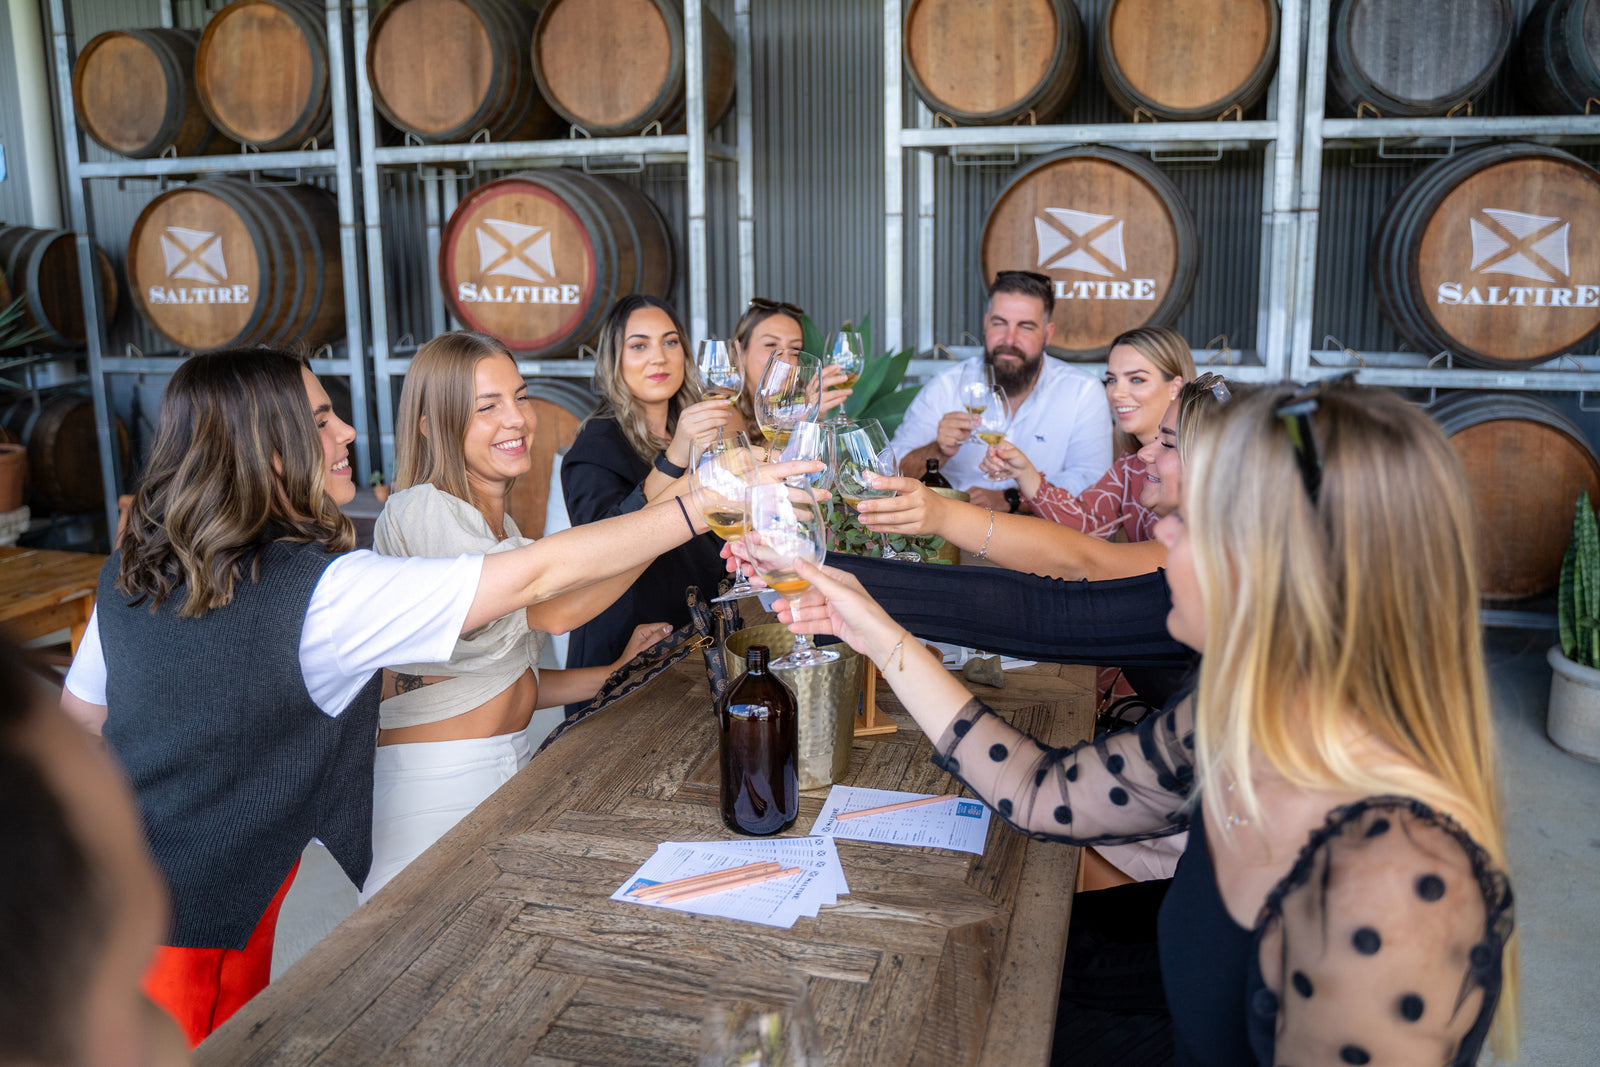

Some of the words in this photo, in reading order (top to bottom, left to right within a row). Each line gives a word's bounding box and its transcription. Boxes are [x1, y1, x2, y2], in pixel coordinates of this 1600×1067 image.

[149, 285, 250, 304] SALTIRE
[458, 281, 580, 304] SALTIRE
[1053, 279, 1156, 300] LTIRE
[1437, 281, 1600, 307] SALTIRE
